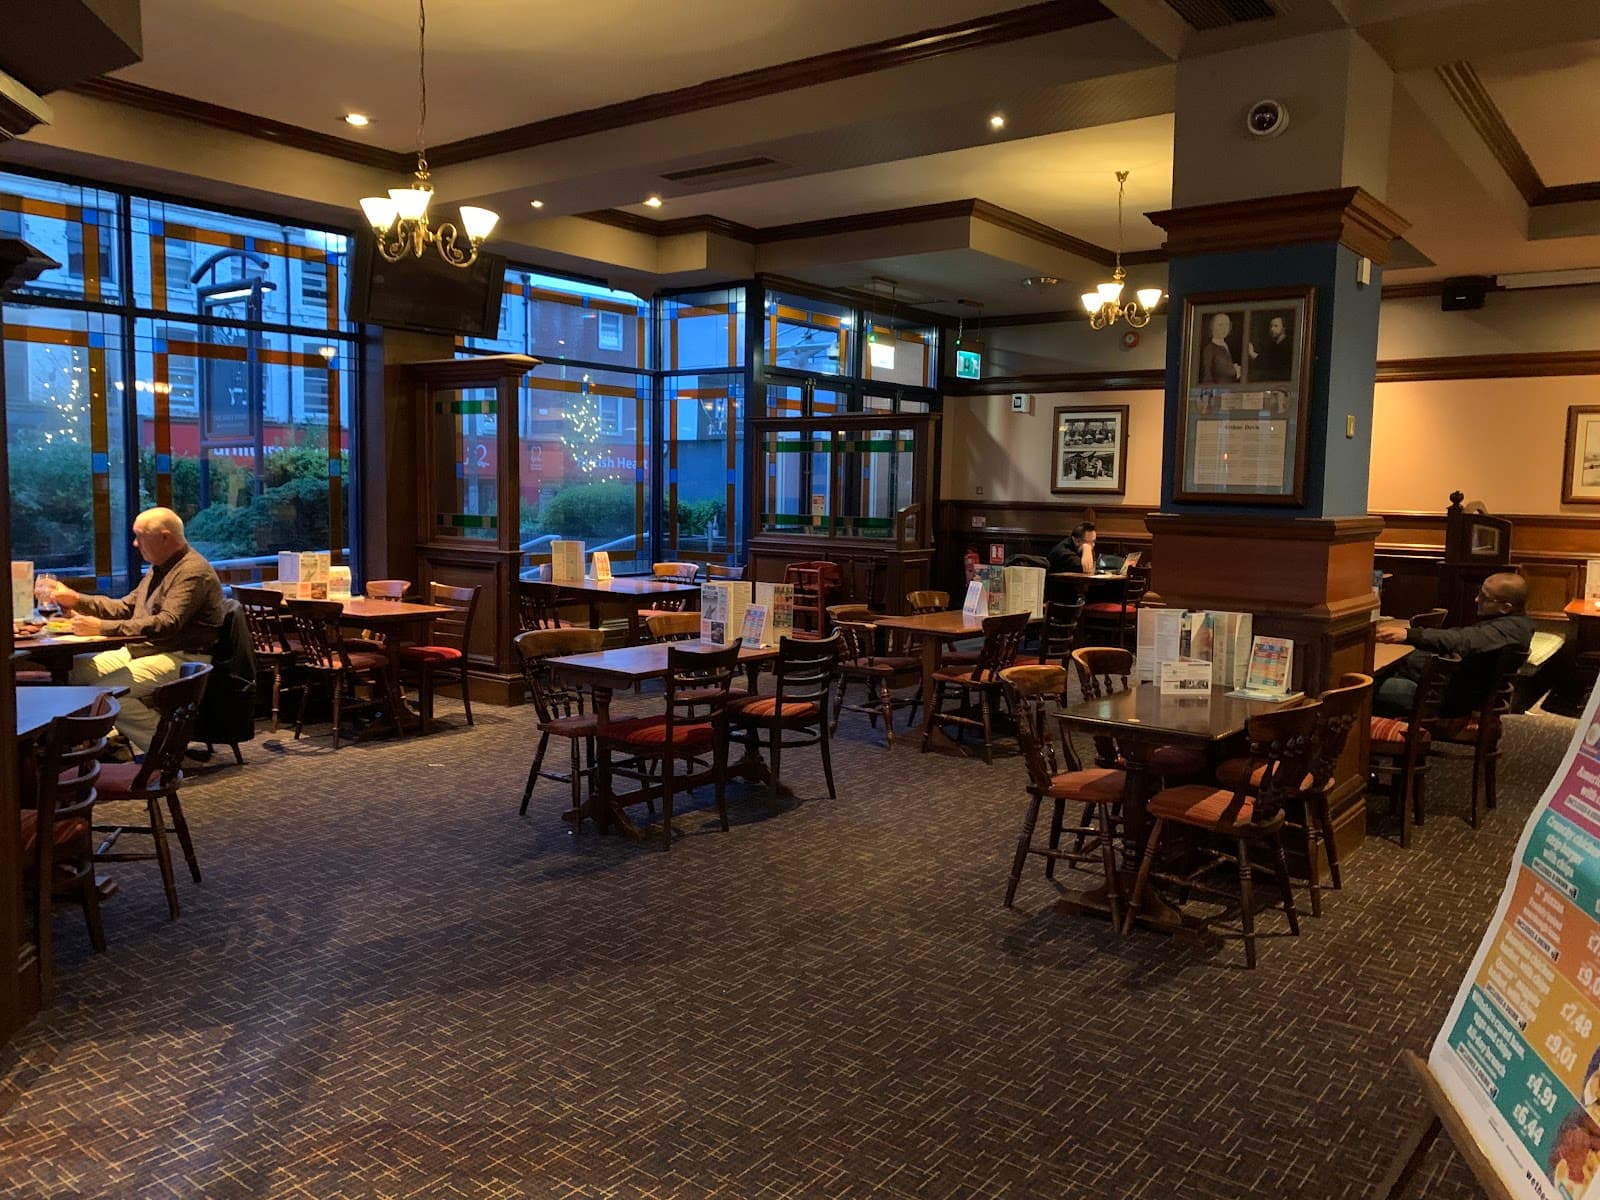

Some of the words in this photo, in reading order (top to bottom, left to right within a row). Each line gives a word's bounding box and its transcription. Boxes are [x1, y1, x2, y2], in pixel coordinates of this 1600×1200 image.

[577, 455, 614, 469] Bish
[617, 456, 648, 470] Heat
[1560, 1002, 1593, 1039] £7.48
[1485, 1046, 1506, 1078] brunch
[1545, 1034, 1578, 1072] £9.01
[1526, 1073, 1558, 1114] £4.91
[1512, 1104, 1545, 1147] £6.44
